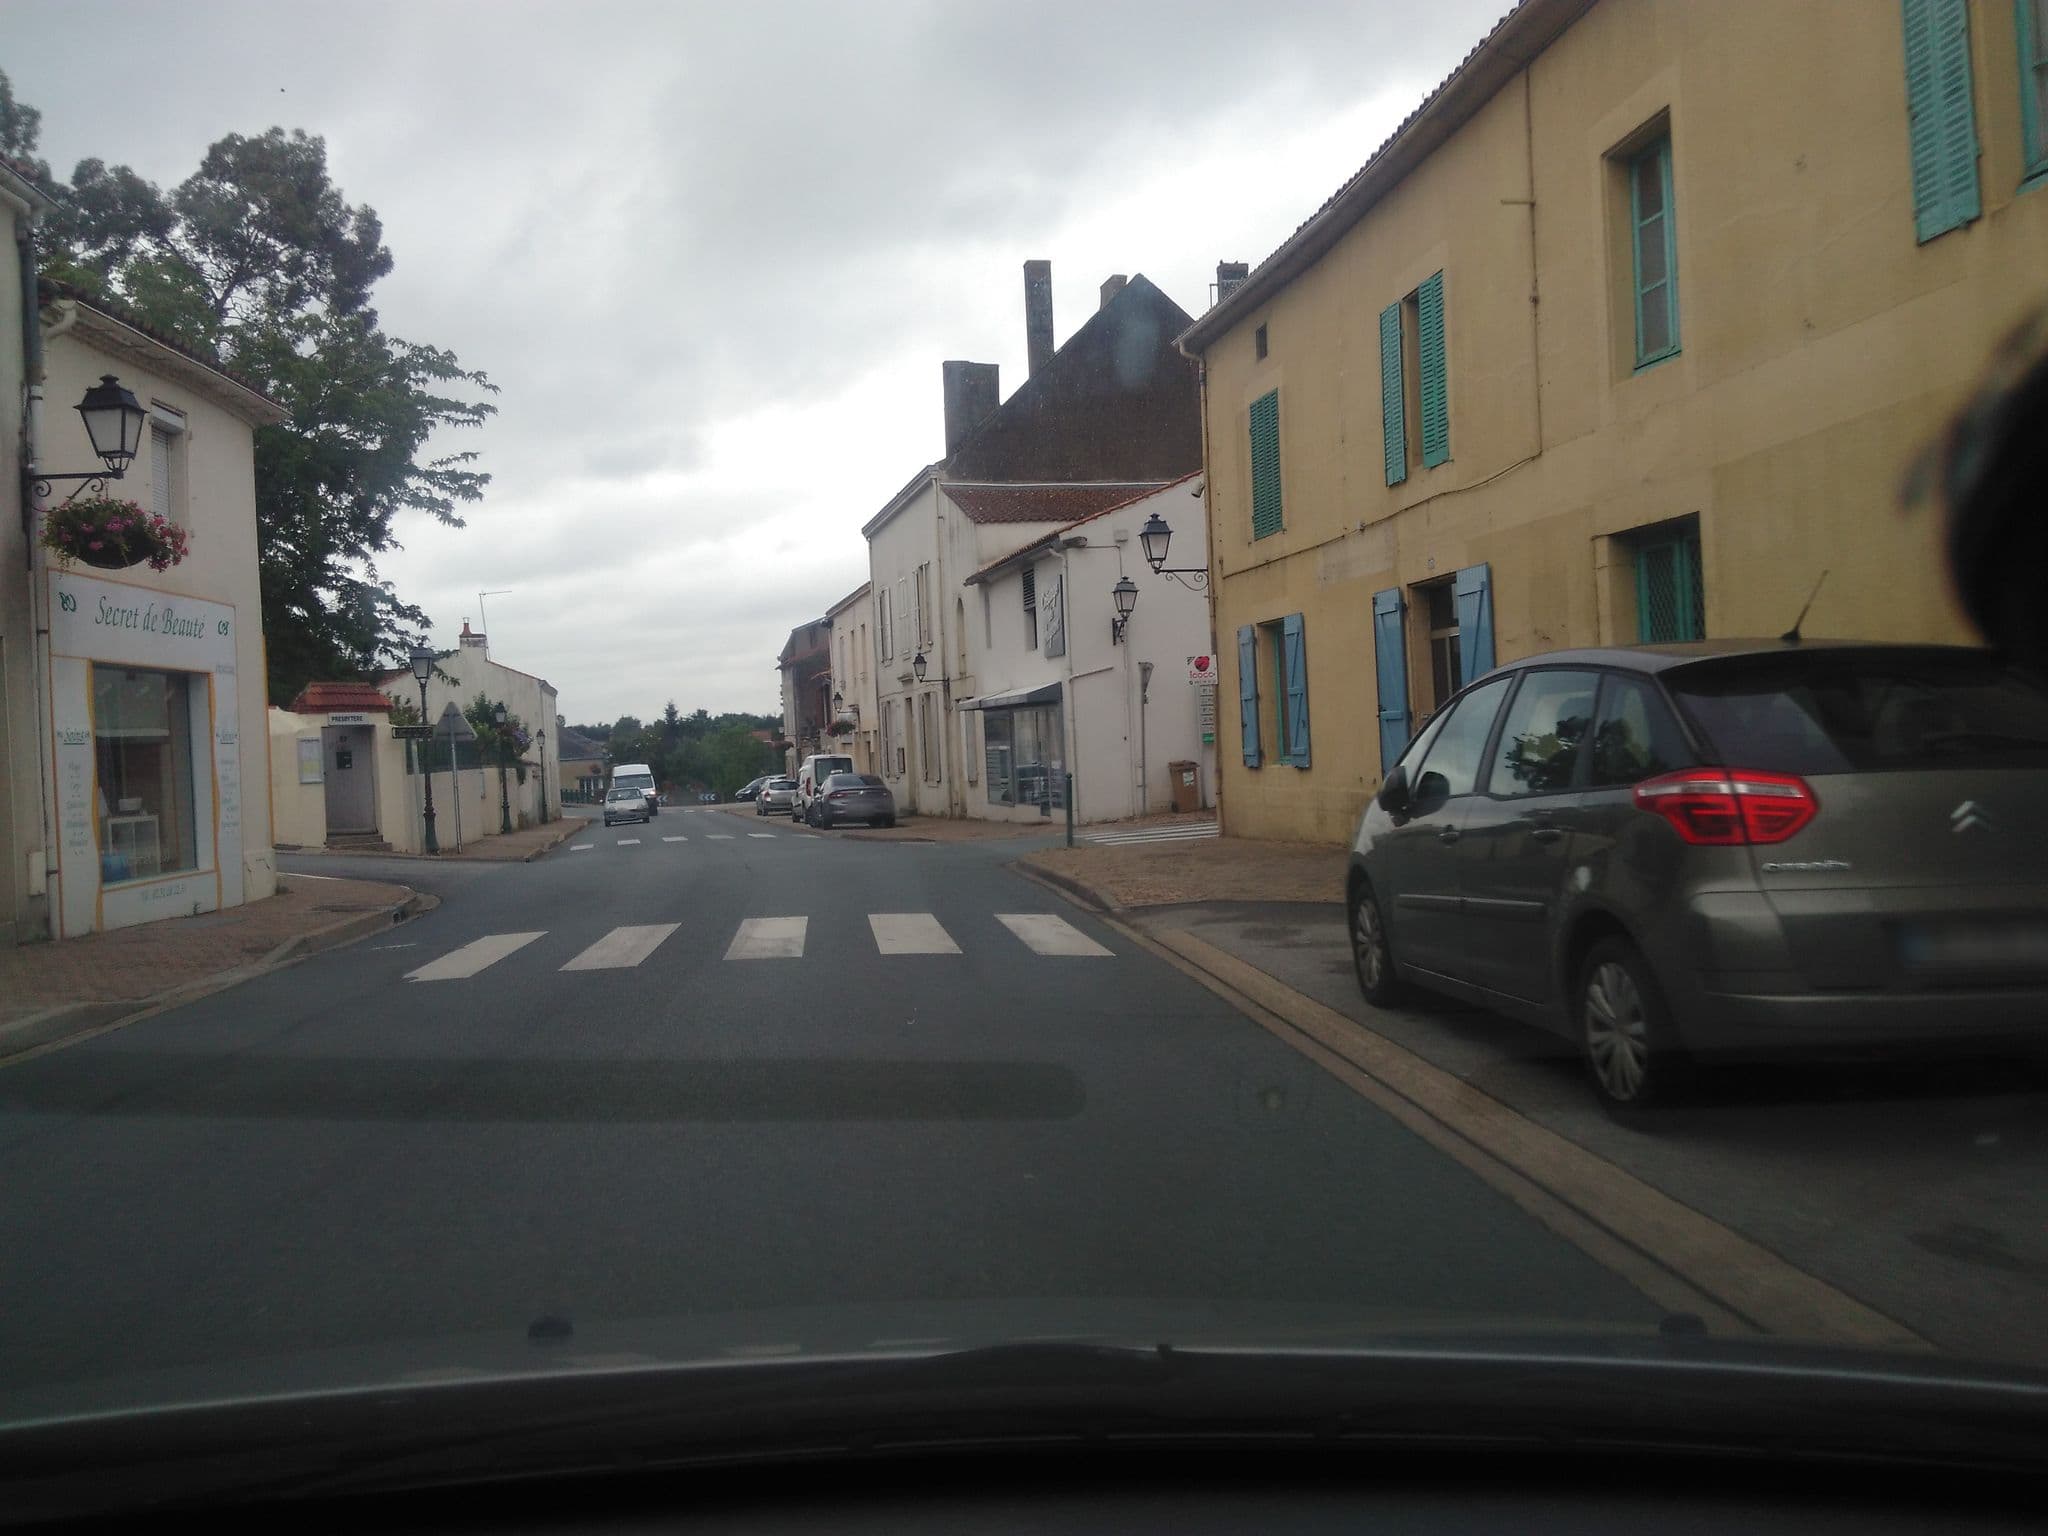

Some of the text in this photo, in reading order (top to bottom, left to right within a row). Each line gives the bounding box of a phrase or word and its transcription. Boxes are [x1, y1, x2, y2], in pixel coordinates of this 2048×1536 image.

[95, 595, 206, 639] Secret de Beauté
